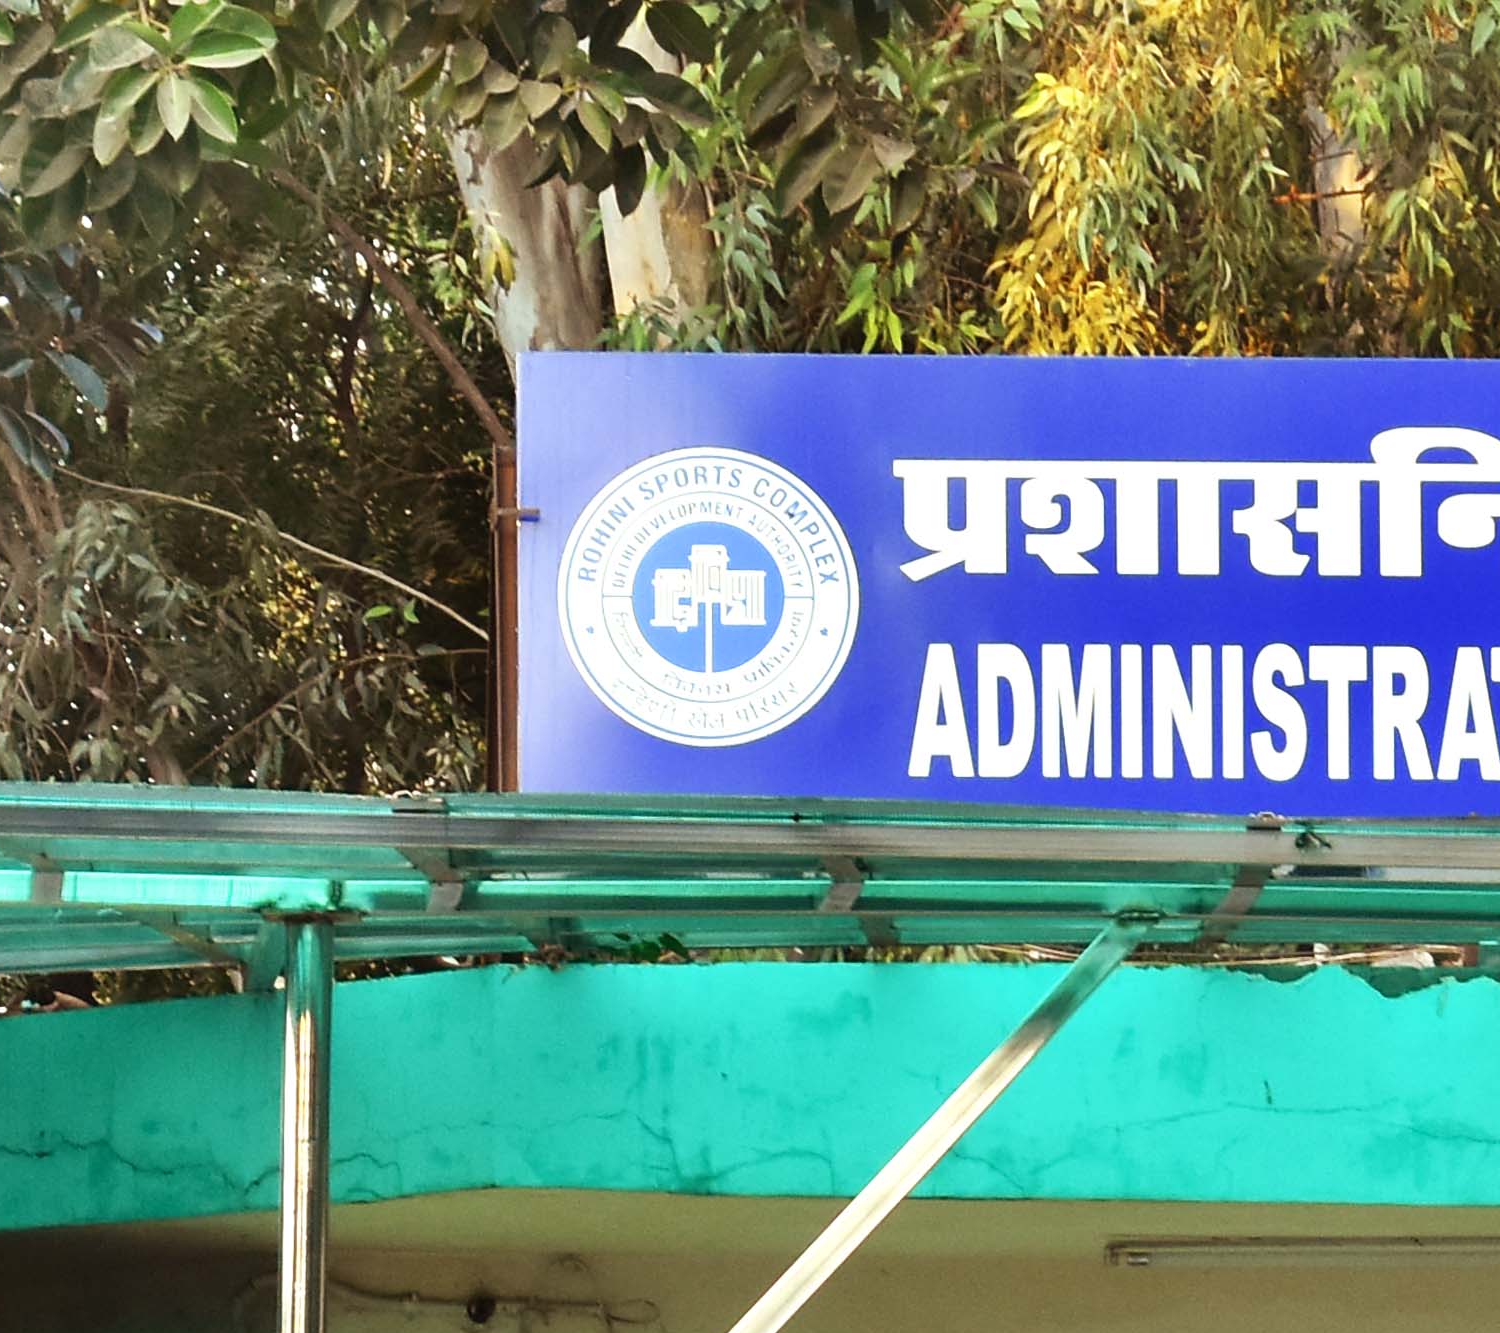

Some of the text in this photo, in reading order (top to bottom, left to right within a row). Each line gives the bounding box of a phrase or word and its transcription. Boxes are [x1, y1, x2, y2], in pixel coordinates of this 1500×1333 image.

[577, 465, 840, 585] ROHINI SPORTS COMPLEX
[633, 501, 744, 545] DEVELOPMENT
[748, 514, 804, 588] AUTHORITY
